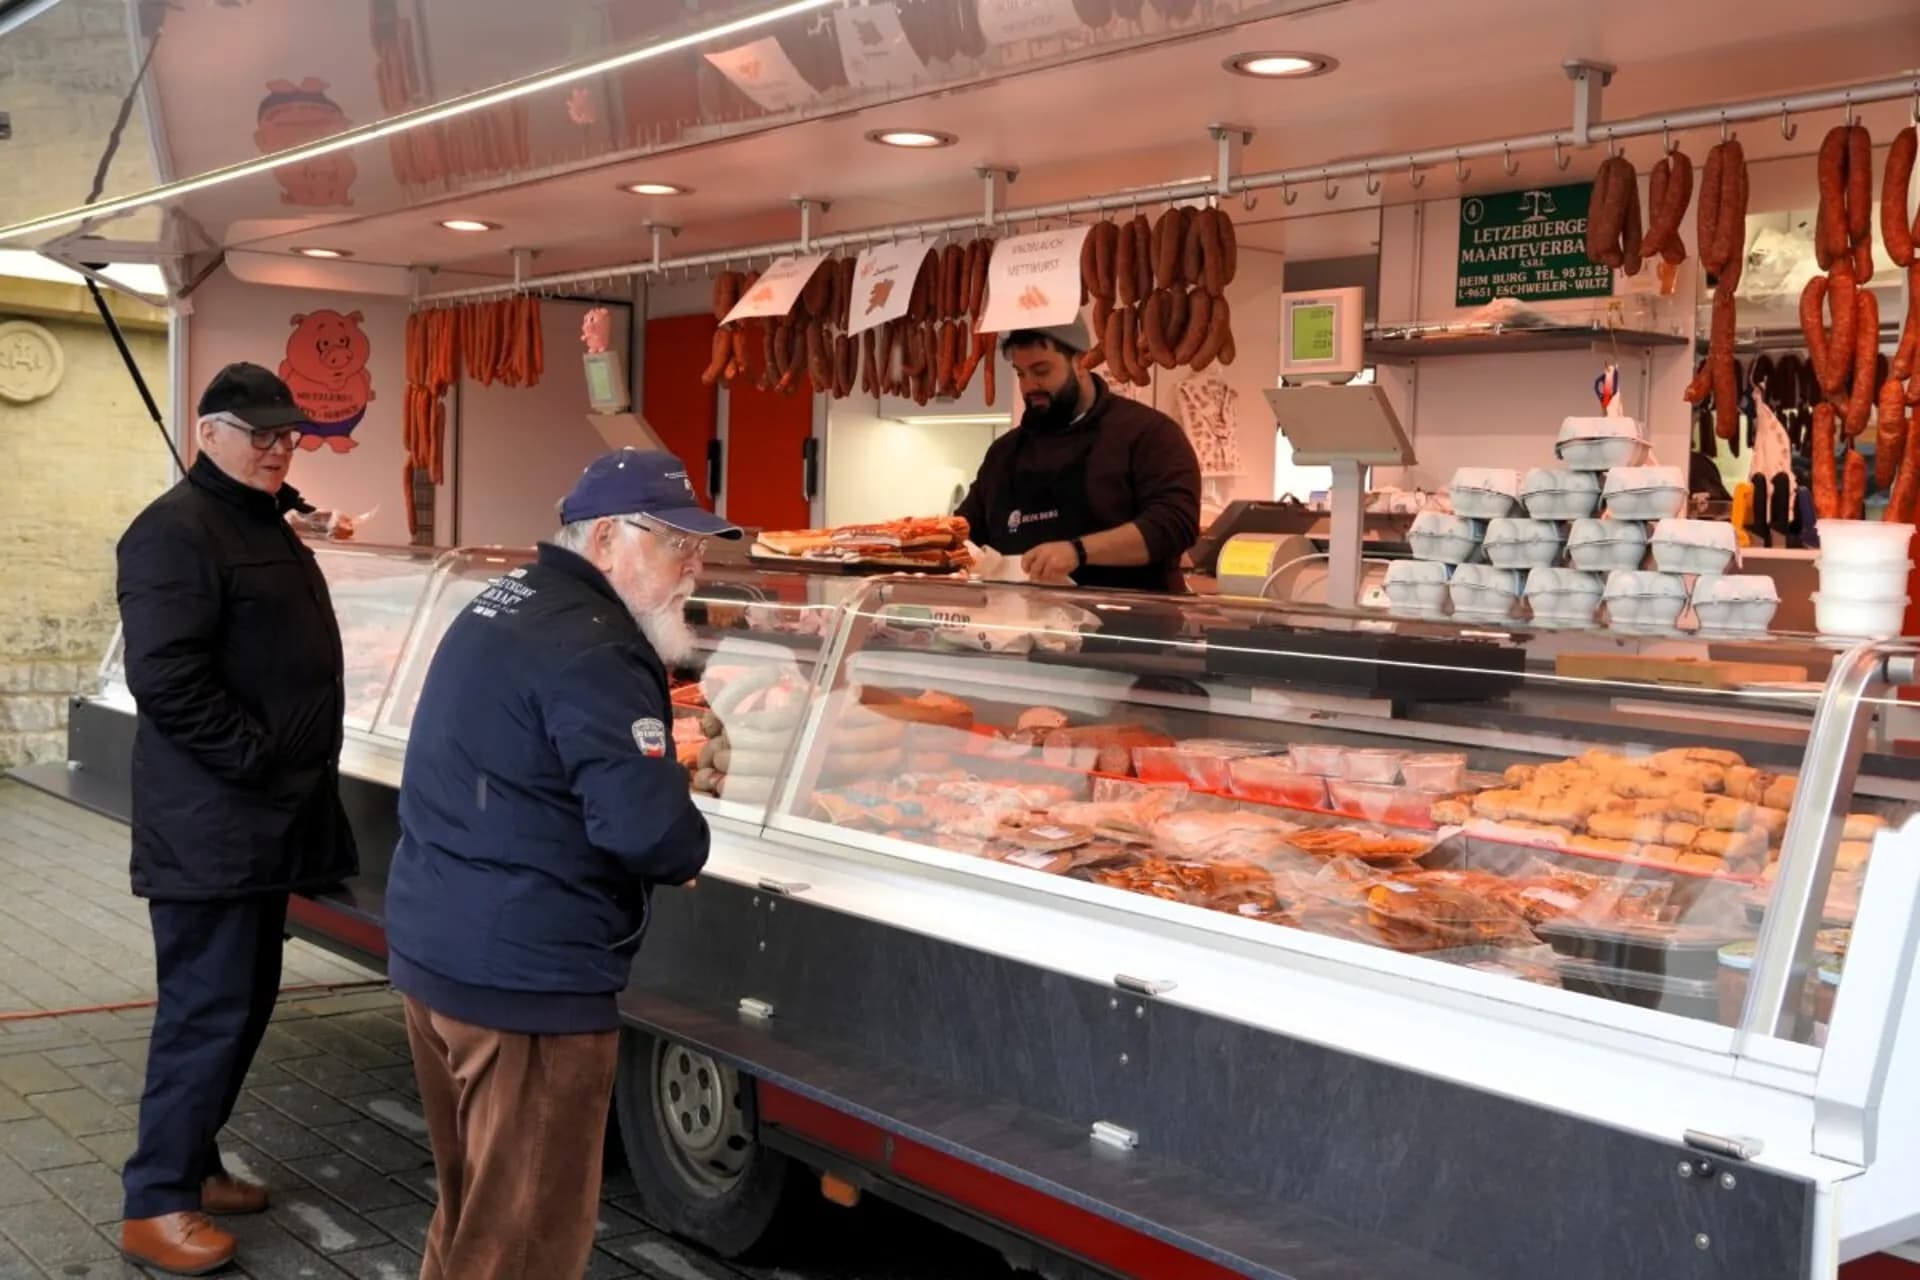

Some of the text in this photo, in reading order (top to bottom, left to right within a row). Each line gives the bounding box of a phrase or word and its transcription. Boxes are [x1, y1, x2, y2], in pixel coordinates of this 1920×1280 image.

[1474, 218, 1588, 244] LETZEBUERGE
[1461, 238, 1586, 264] MAARTEVERBA
[1459, 274, 1488, 288] BEIM
[1492, 271, 1527, 285] BURG
[1496, 280, 1567, 296] ESCHWEILER
[1575, 277, 1608, 290] WILTZ
